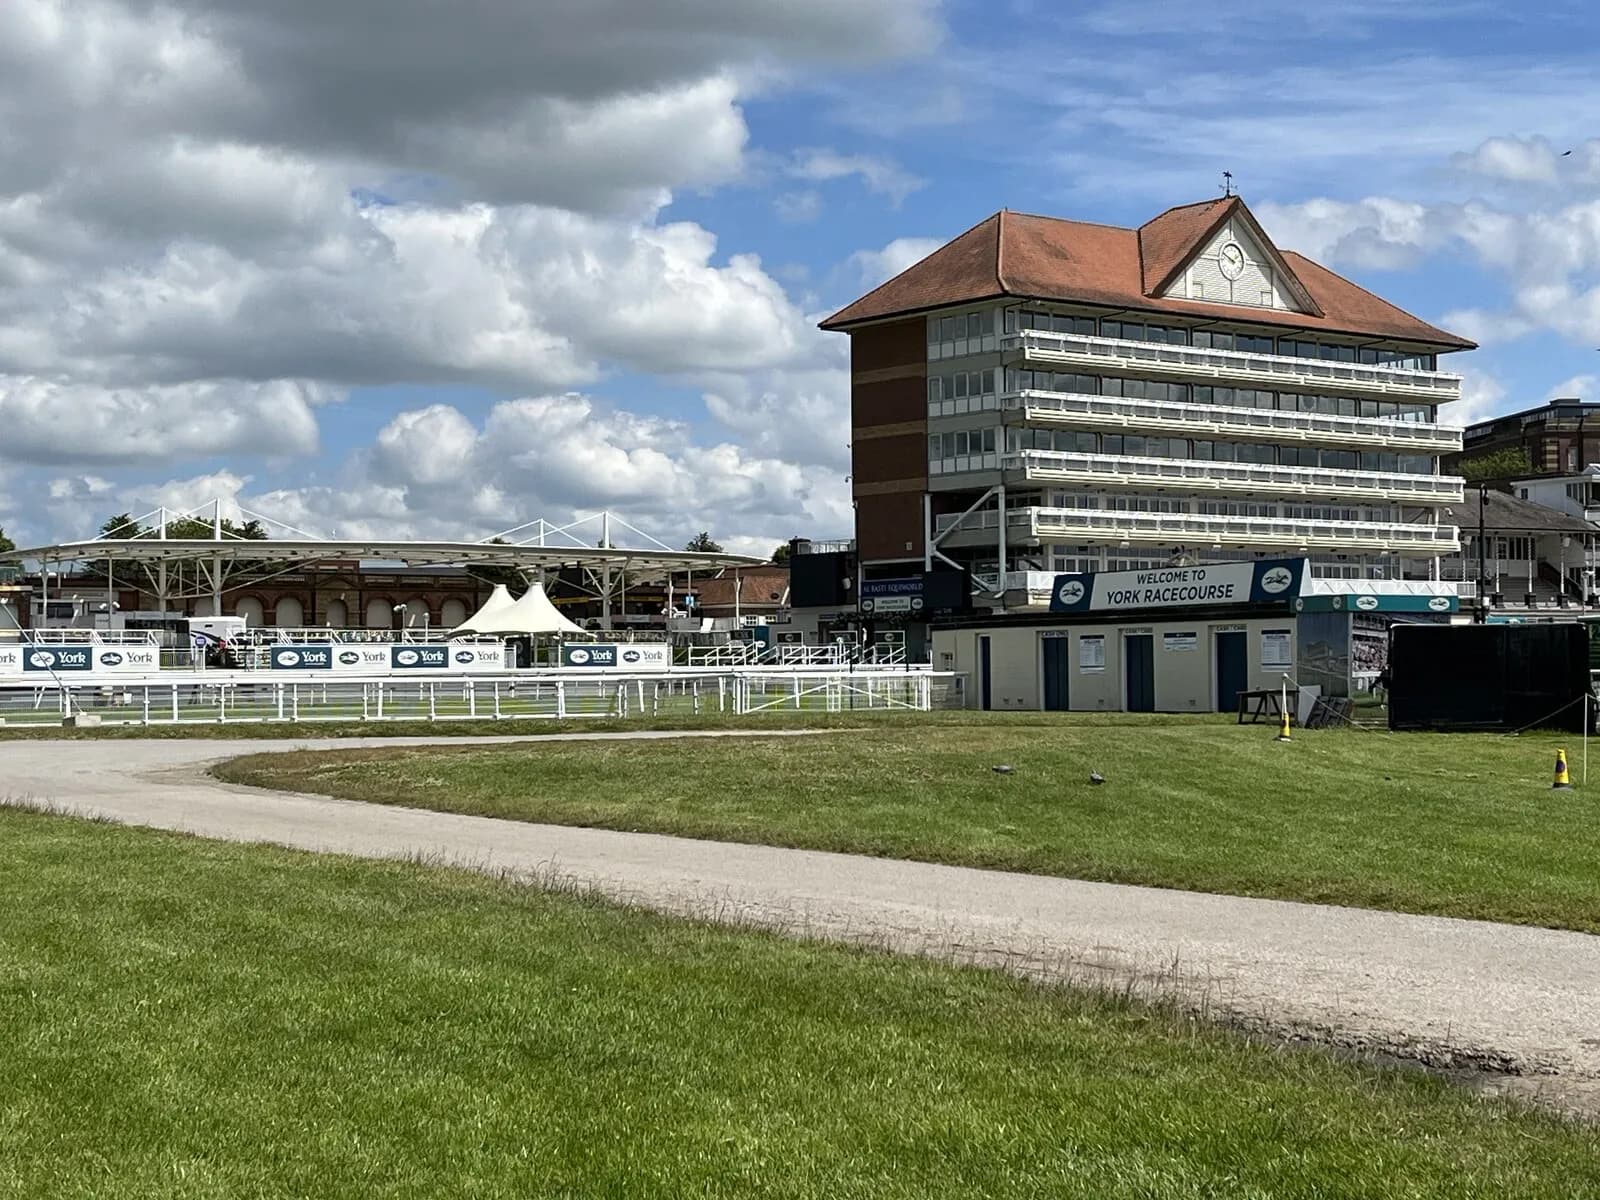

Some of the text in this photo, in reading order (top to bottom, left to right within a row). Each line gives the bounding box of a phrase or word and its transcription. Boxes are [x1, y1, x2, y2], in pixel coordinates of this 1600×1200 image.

[1137, 569, 1206, 585] WELCOME TO
[1107, 584, 1234, 605] YORK RACECOURSE
[0, 652, 16, 663] ork
[58, 651, 86, 663] York
[126, 651, 153, 663] York
[302, 651, 327, 662] York
[362, 651, 386, 662] York
[421, 650, 444, 661] York
[477, 651, 499, 661] York
[591, 650, 612, 660] York
[643, 650, 663, 660] York
